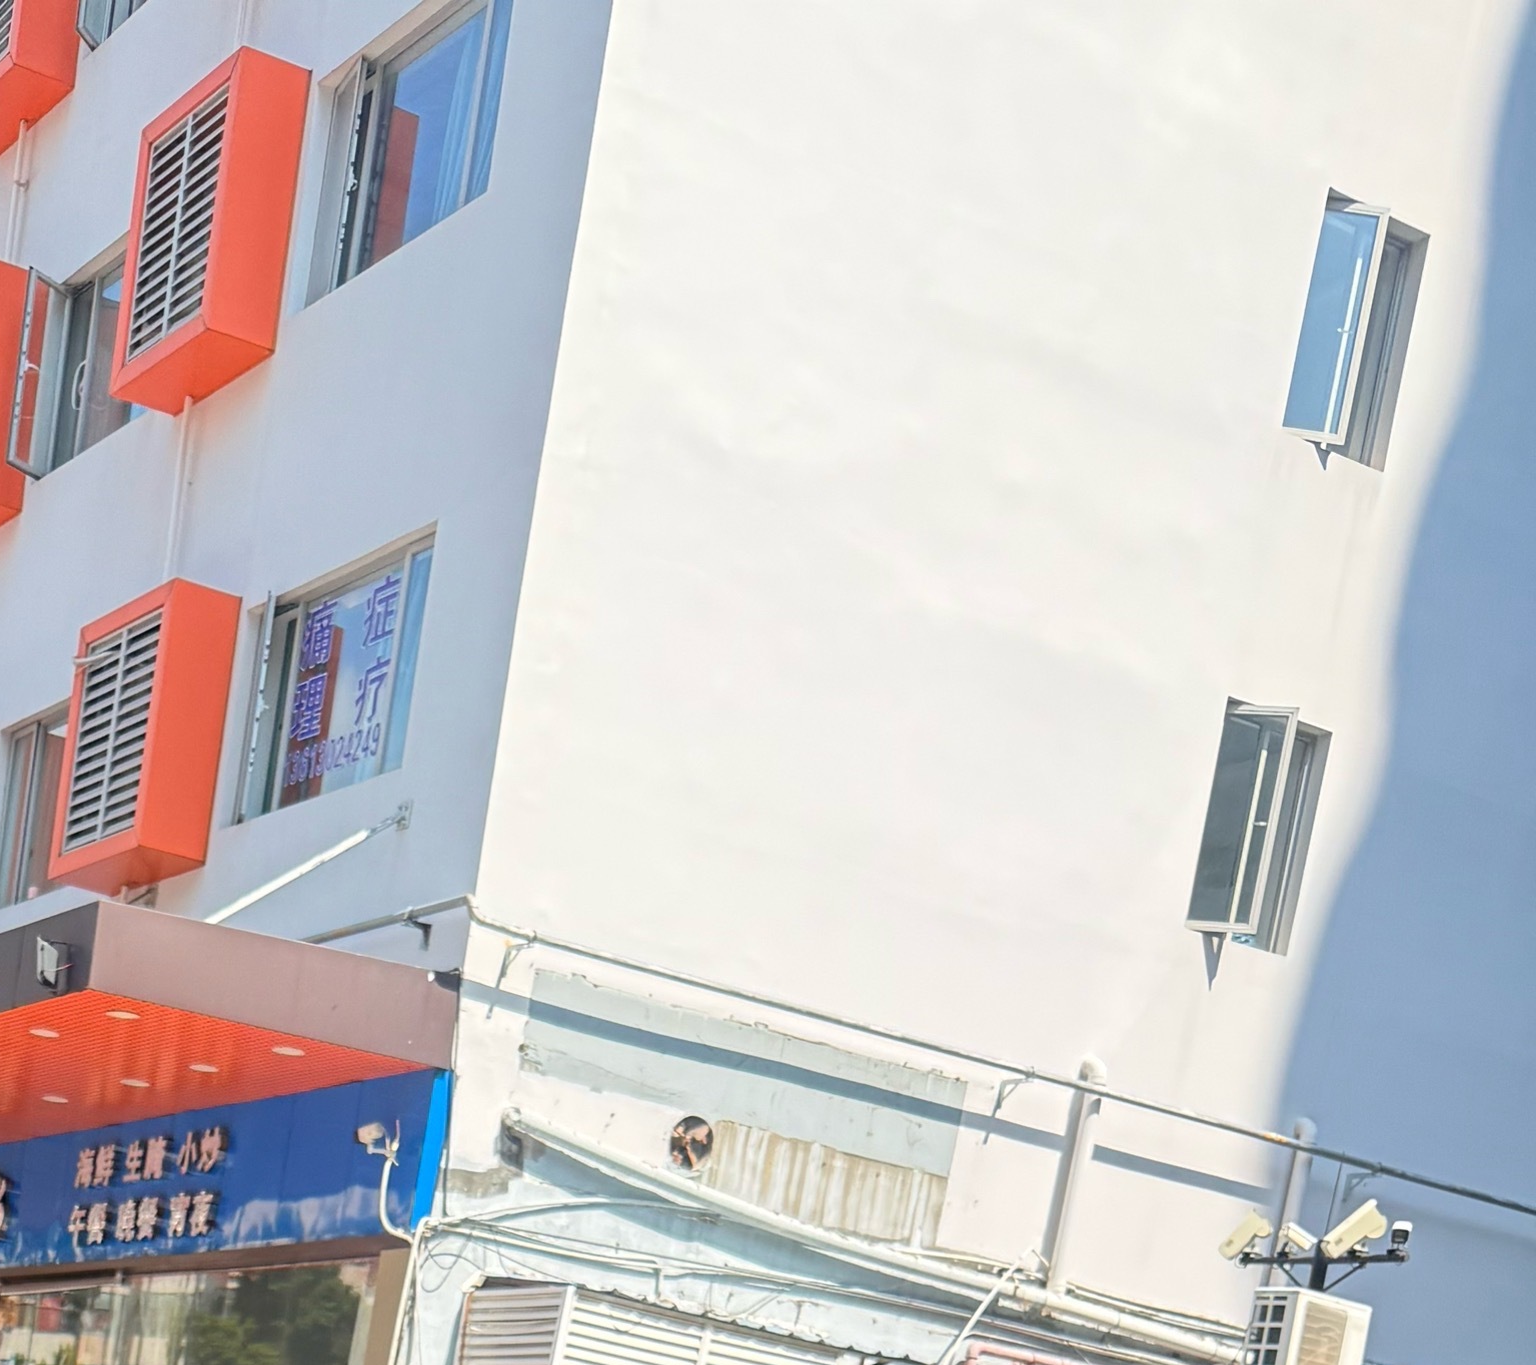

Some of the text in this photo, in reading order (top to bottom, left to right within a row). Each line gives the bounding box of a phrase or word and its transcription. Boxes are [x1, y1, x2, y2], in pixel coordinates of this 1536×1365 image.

[74, 1144, 115, 1188] 海鲜
[176, 1126, 222, 1175] 小炒
[68, 1202, 108, 1245] 午餐
